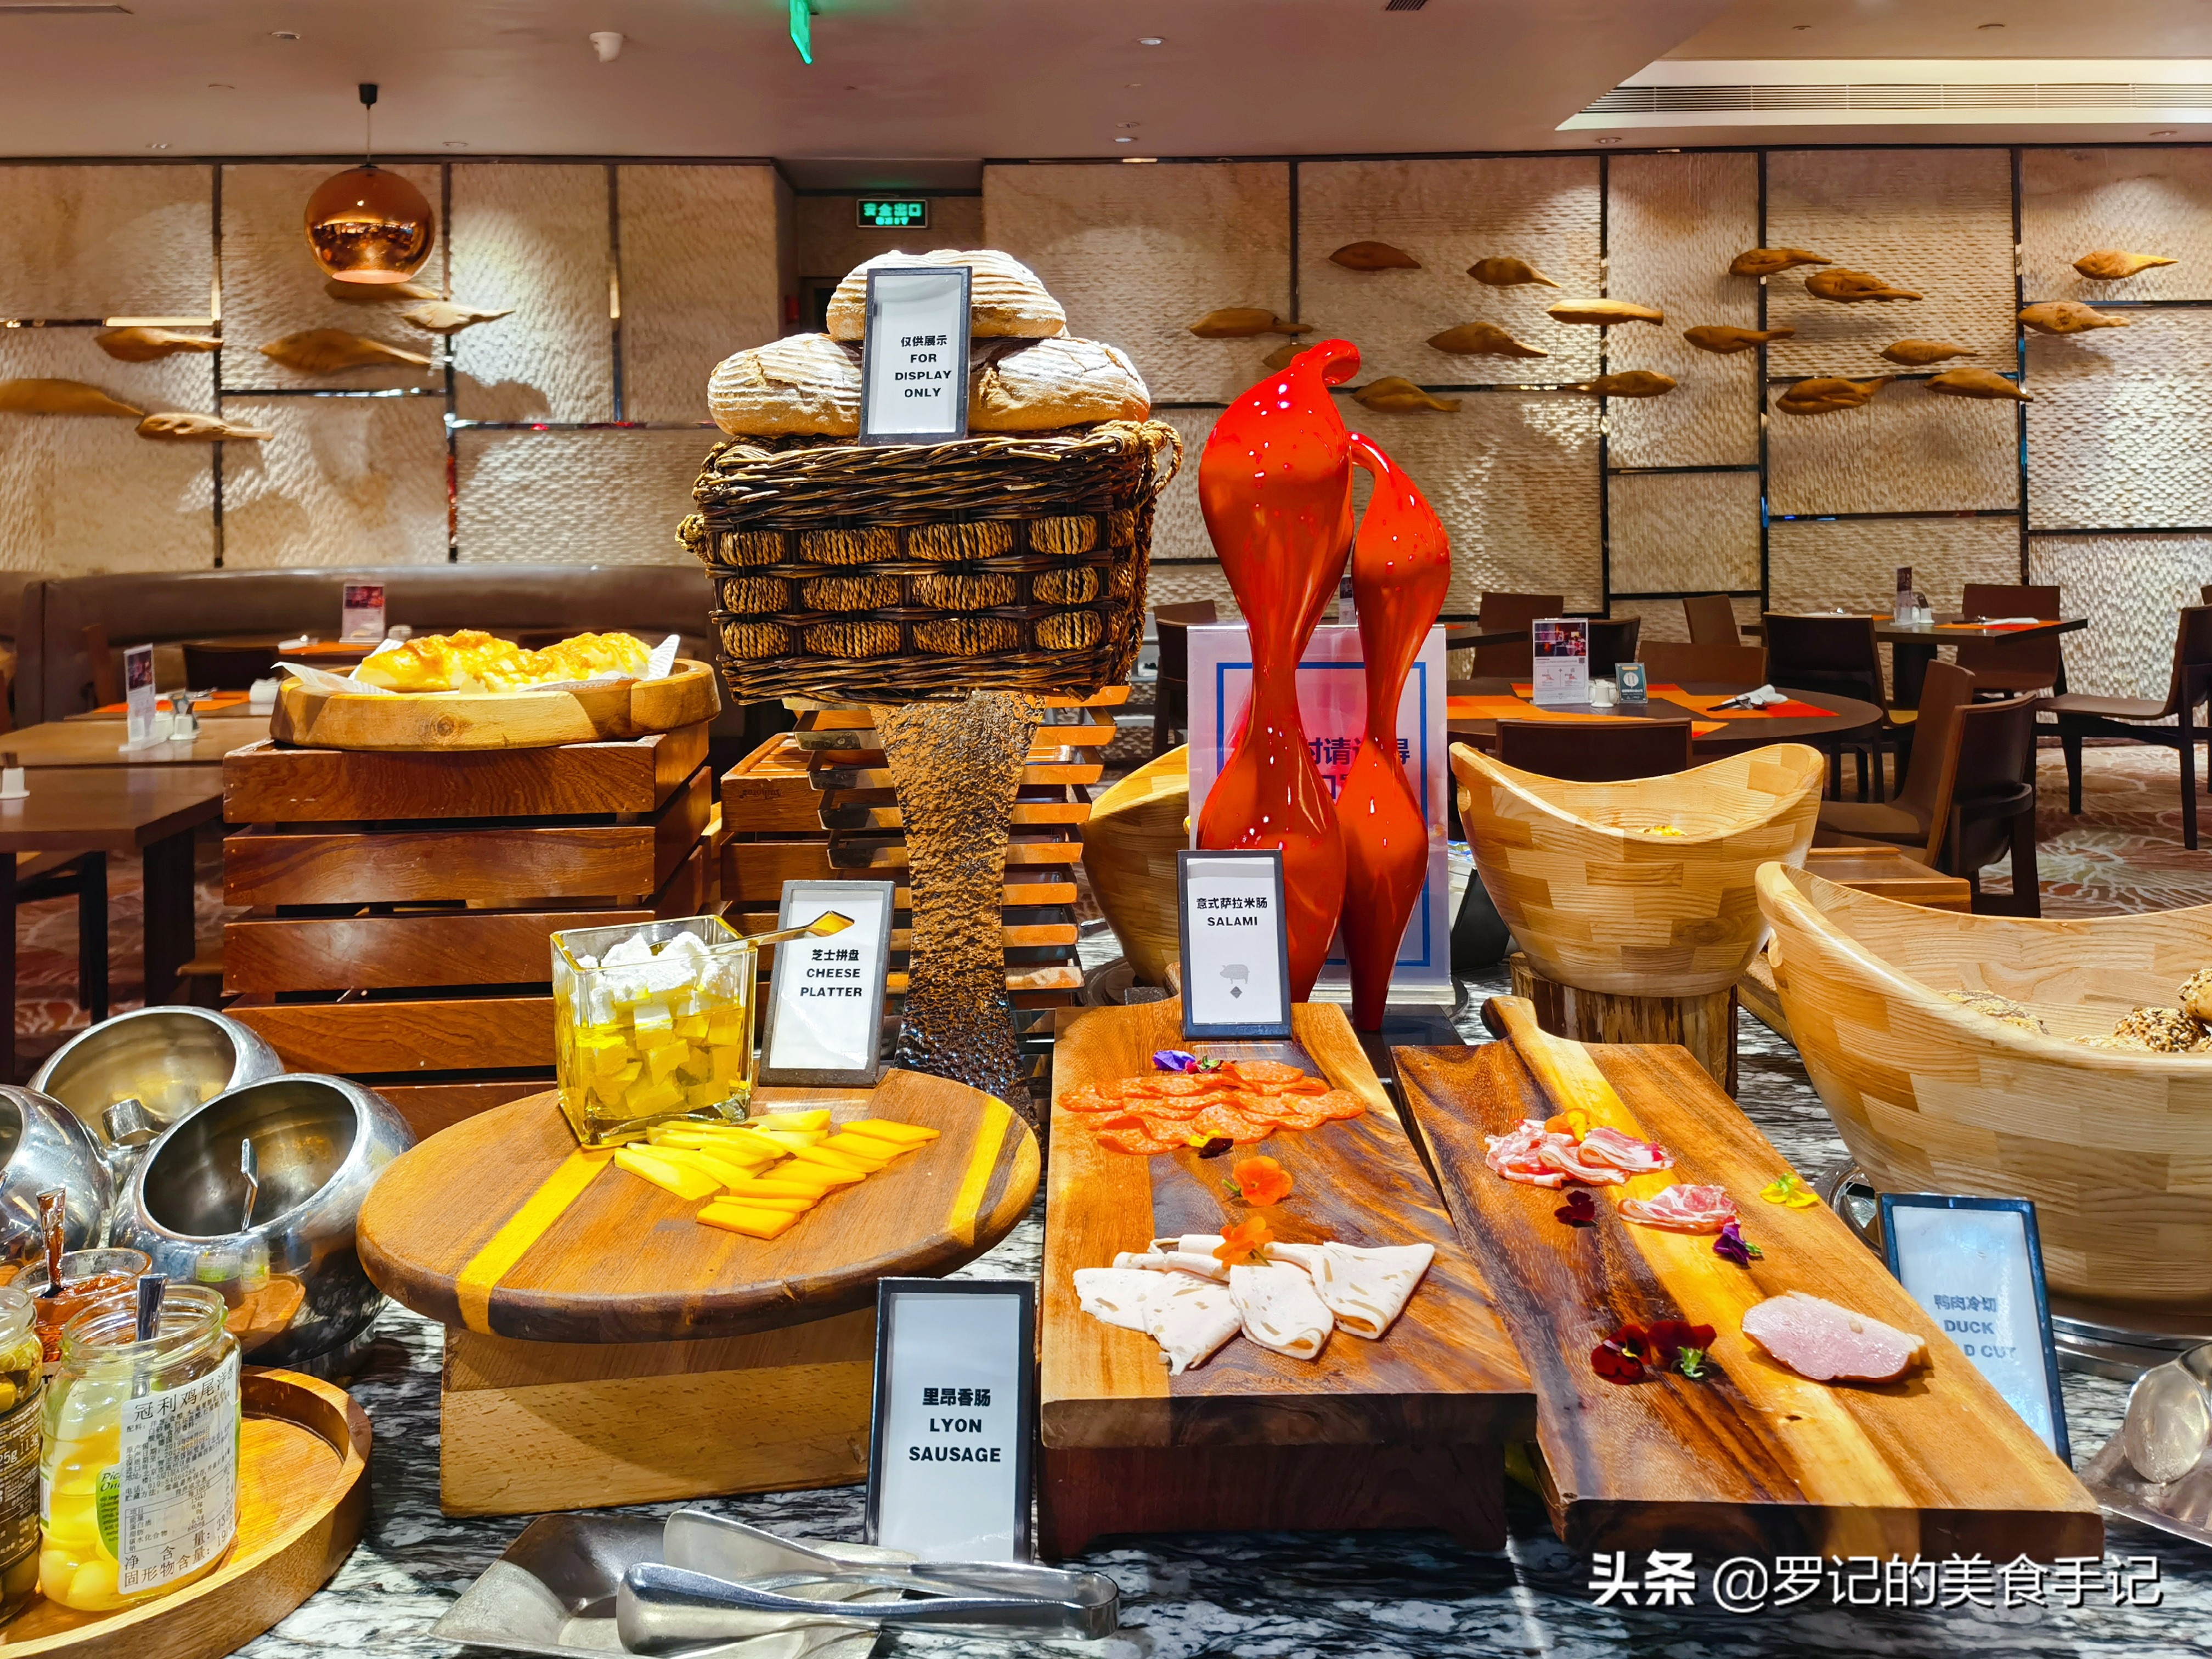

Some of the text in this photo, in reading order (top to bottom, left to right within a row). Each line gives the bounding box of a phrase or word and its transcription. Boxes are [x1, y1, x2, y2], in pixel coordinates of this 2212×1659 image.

[900, 335, 947, 347] 仅供展示
[910, 353, 937, 363] FOR
[894, 370, 952, 381] DISPLAY
[904, 387, 942, 398] ONLY
[1196, 897, 1268, 910] 意式萨拉米肠
[1207, 916, 1258, 927] SALAMI
[811, 949, 860, 962] 芝士拼盘
[806, 968, 861, 978] CHEESE
[799, 987, 862, 997] PLATTER
[1943, 1319, 1995, 1335] DUCK
[1980, 1344, 2017, 1359] CUT
[922, 1387, 991, 1407] 里昂香肠
[929, 1418, 982, 1433] LYON
[909, 1446, 1001, 1463] SAUSAGE
